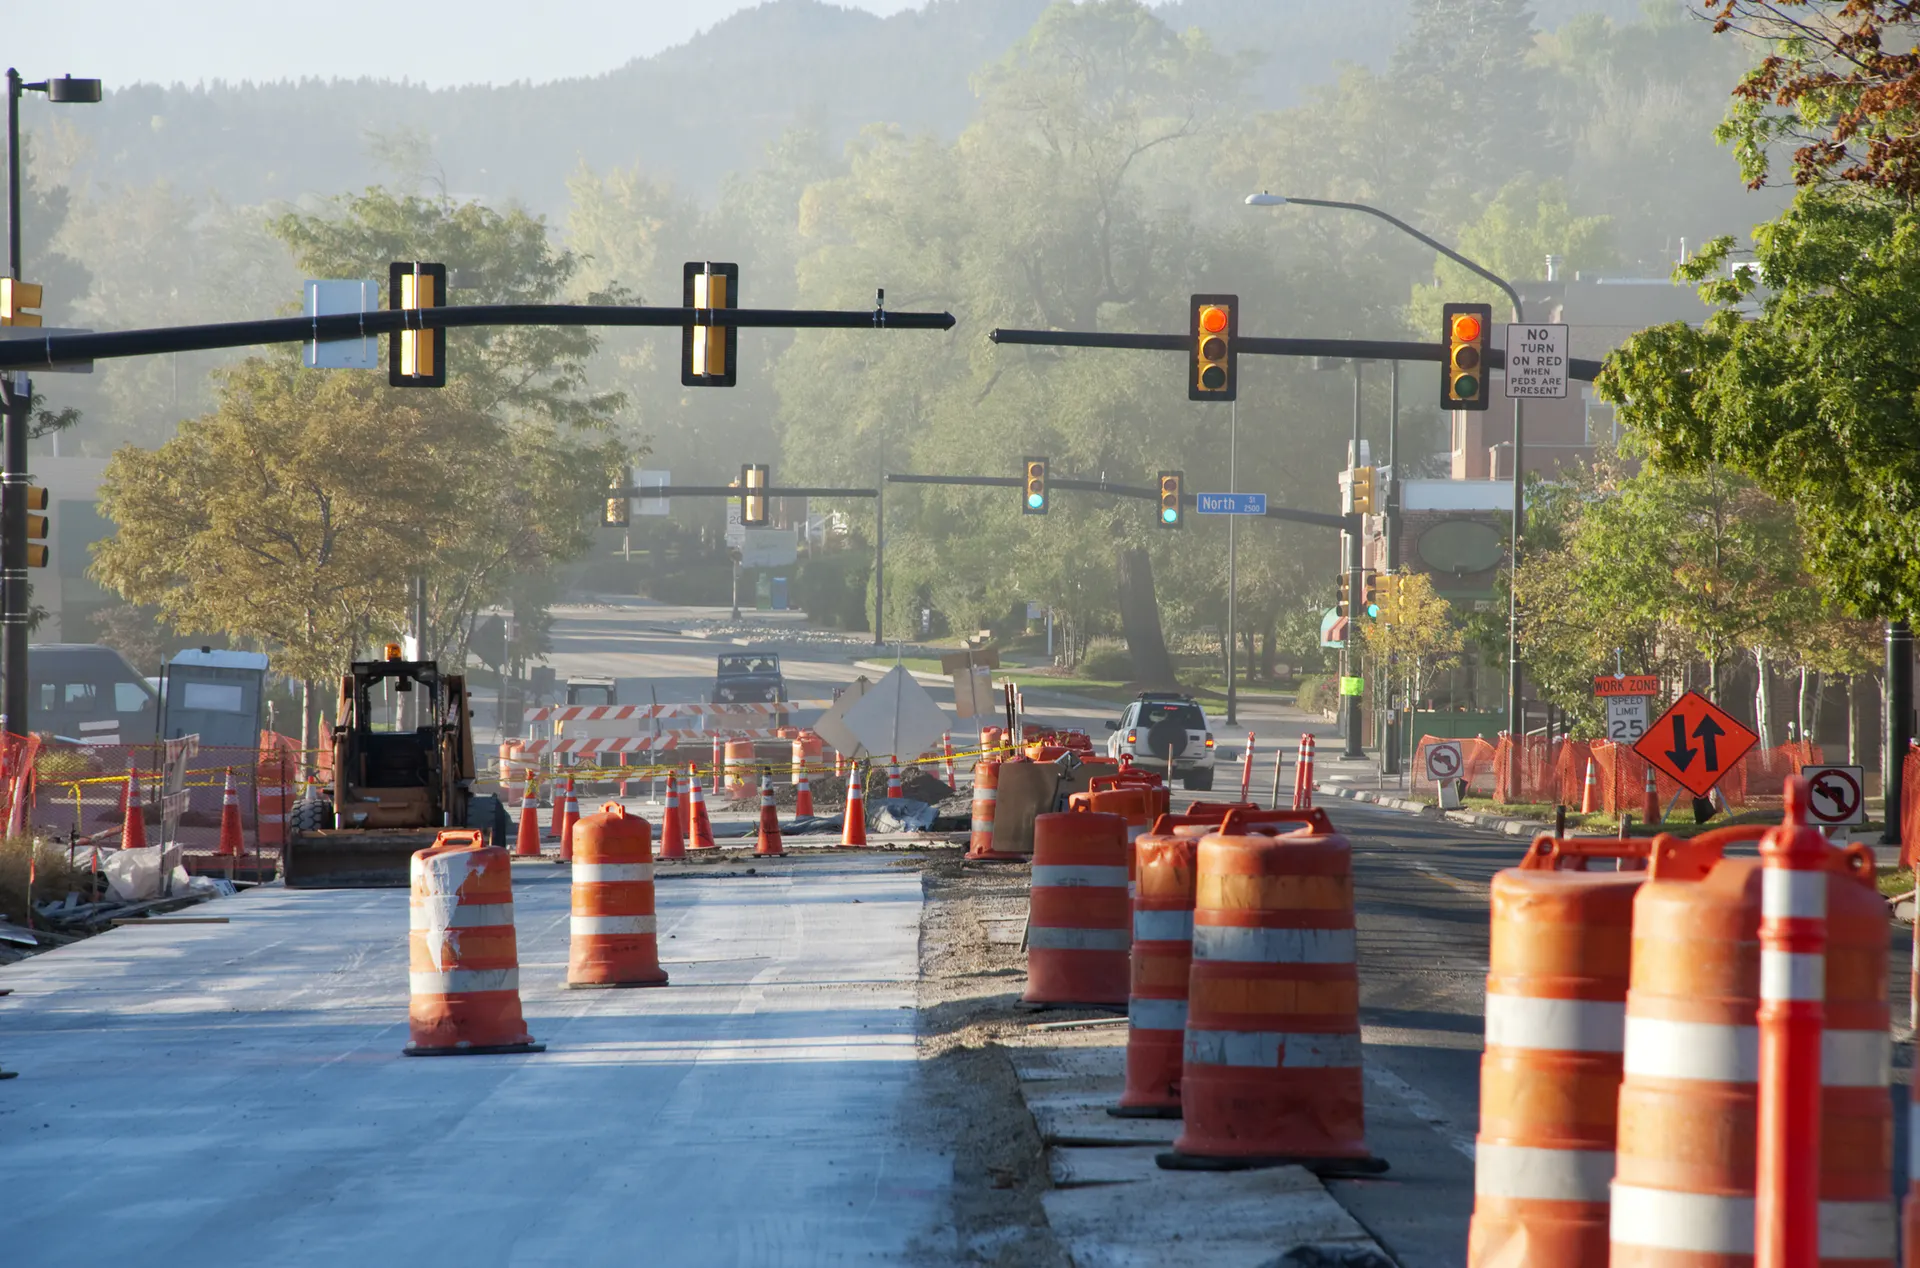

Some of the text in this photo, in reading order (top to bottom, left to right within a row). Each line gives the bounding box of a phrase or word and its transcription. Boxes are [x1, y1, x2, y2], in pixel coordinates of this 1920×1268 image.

[1527, 329, 1549, 341] NO
[1520, 344, 1554, 353] TURN
[1512, 356, 1562, 366] ON RED
[1523, 368, 1550, 376] WHEN
[1511, 377, 1536, 385] PEDS
[1513, 386, 1558, 395] PRESENT
[1203, 496, 1235, 510] North
[1244, 504, 1260, 512] 2500
[1594, 679, 1657, 692] WORK ZONE
[1612, 697, 1643, 706] SPEED
[1615, 707, 1639, 716] LIMIT
[1612, 720, 1644, 738] 25
